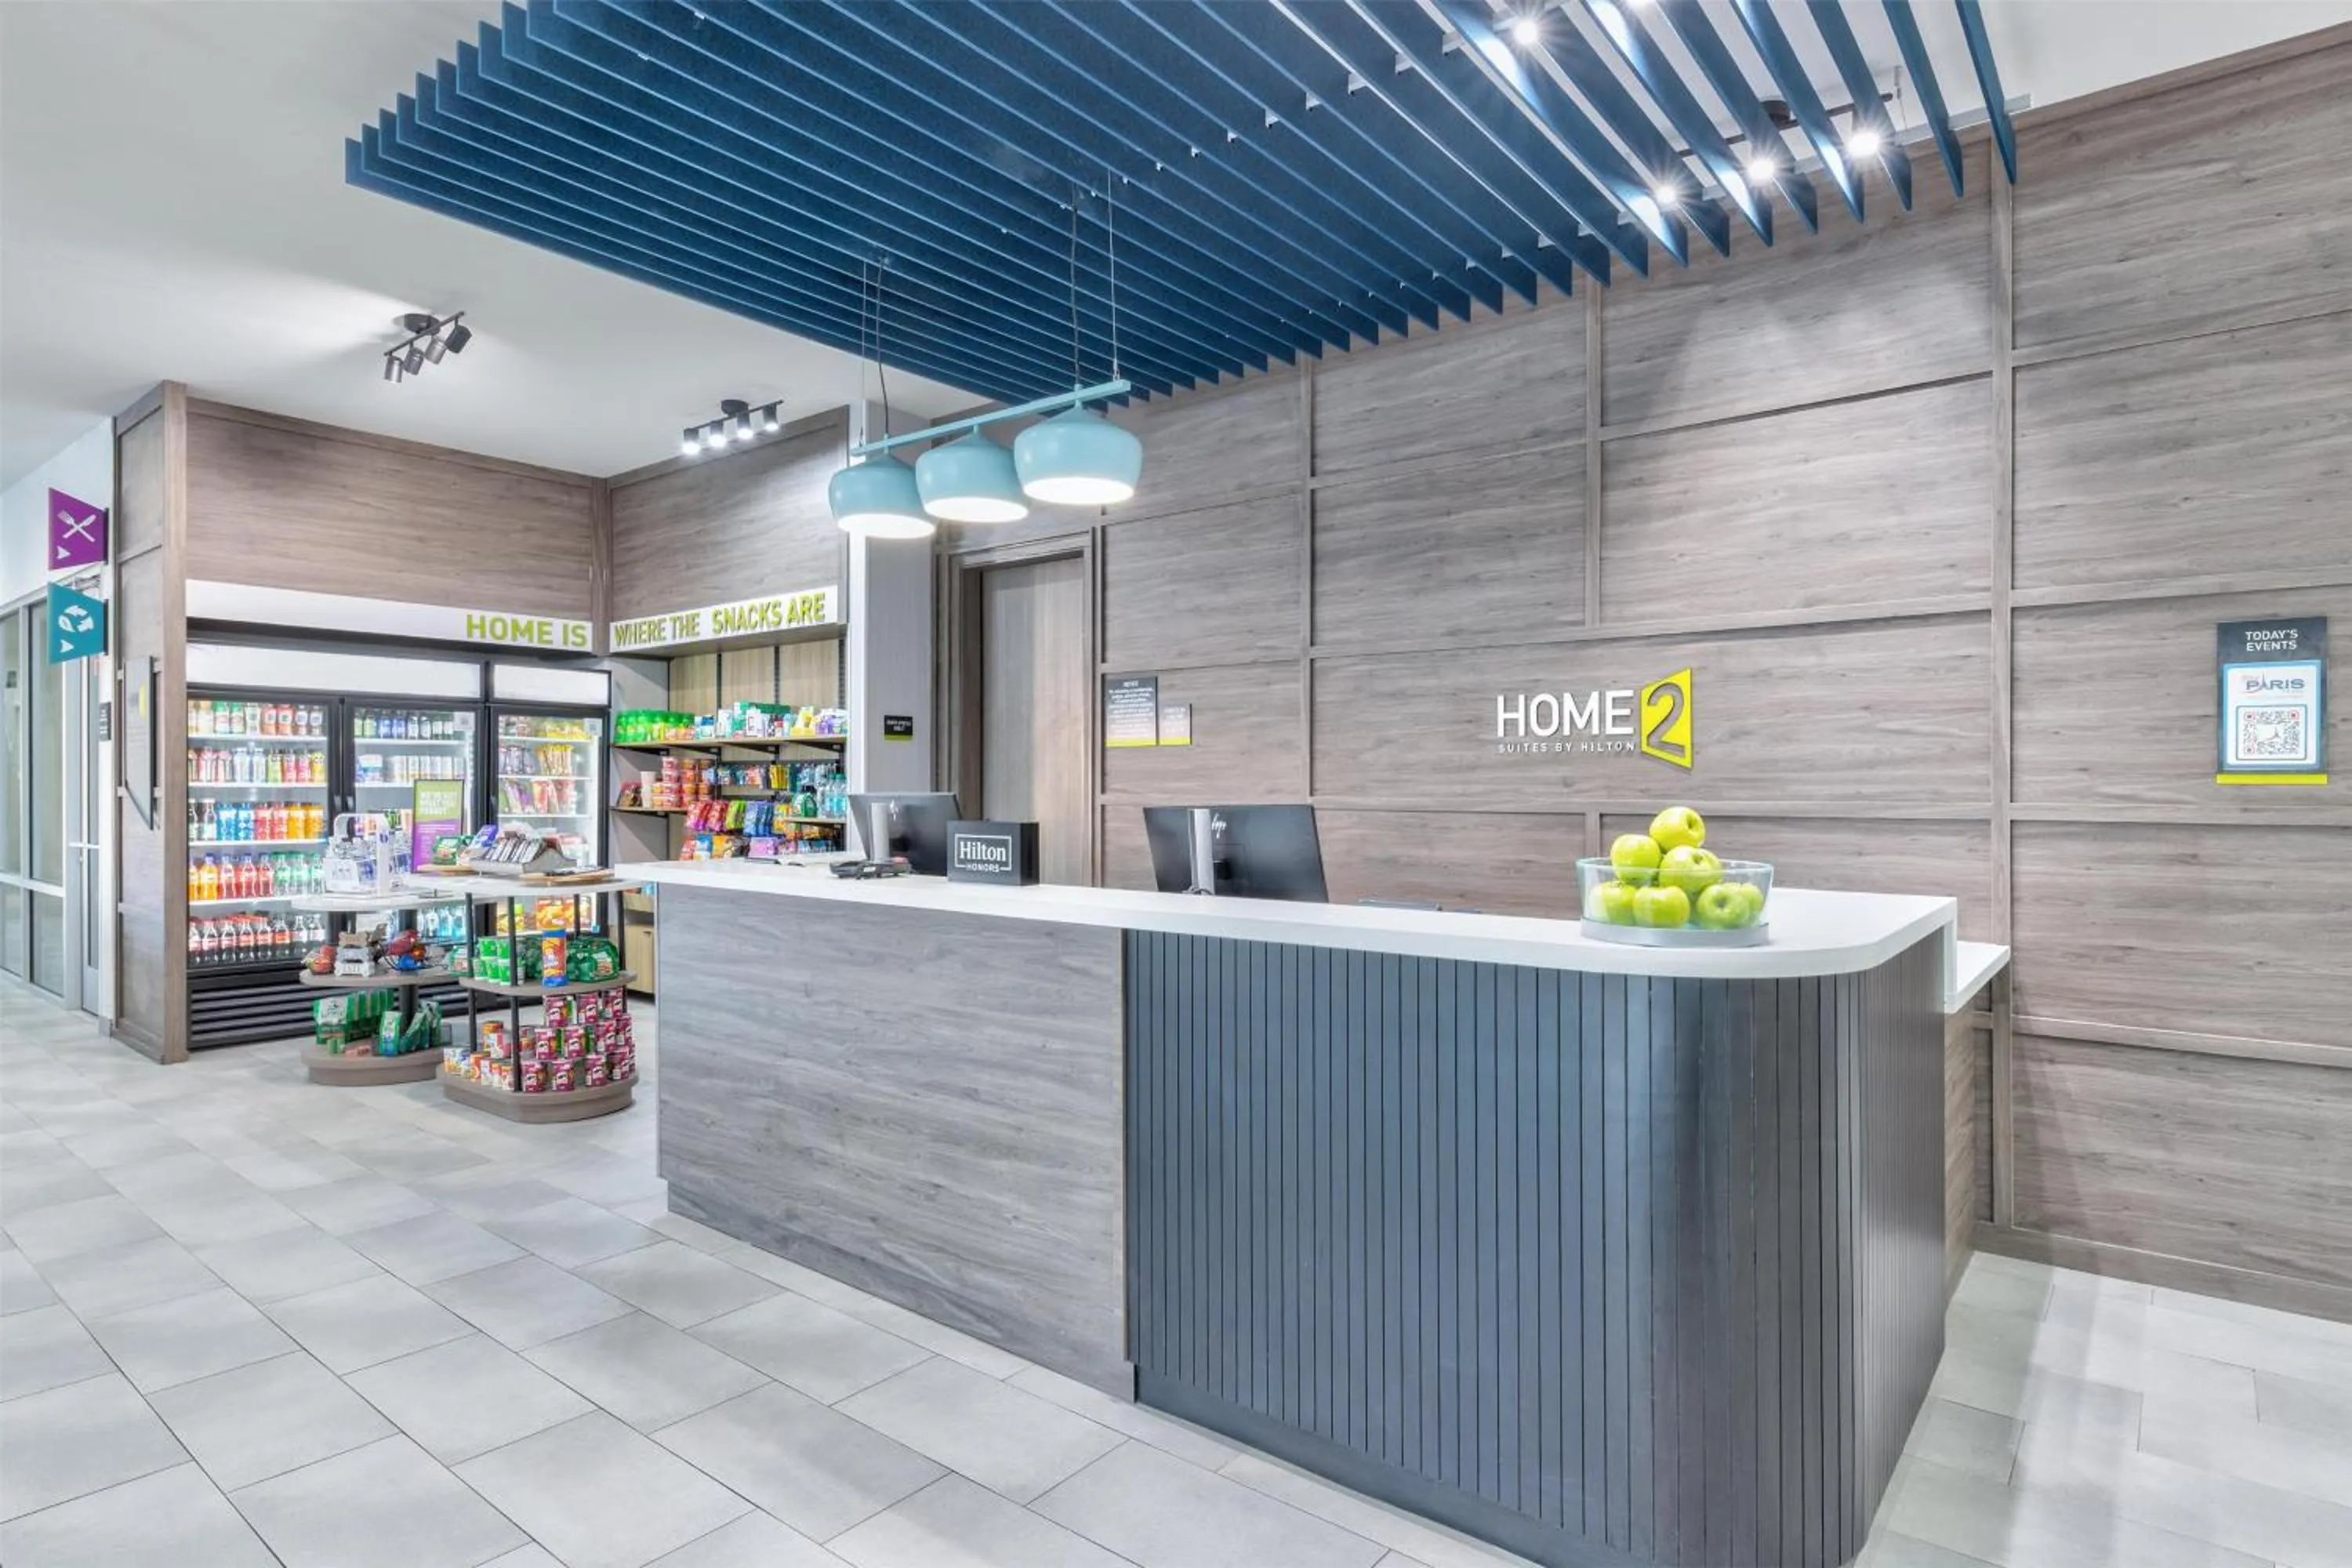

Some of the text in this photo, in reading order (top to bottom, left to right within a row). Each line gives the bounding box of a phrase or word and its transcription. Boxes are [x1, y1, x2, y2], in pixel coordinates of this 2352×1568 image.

[615, 592, 826, 647] WHERE THE SNACKS ARE
[466, 614, 587, 647] HOME IS
[2245, 628, 2299, 641] TODAY'S
[2246, 640, 2297, 652] EVENTS
[2246, 673, 2305, 691] PARIS
[1497, 681, 1686, 760] HOME 2
[1498, 741, 1635, 753] SUITES BY HILTON
[959, 841, 1007, 862] Hilton
